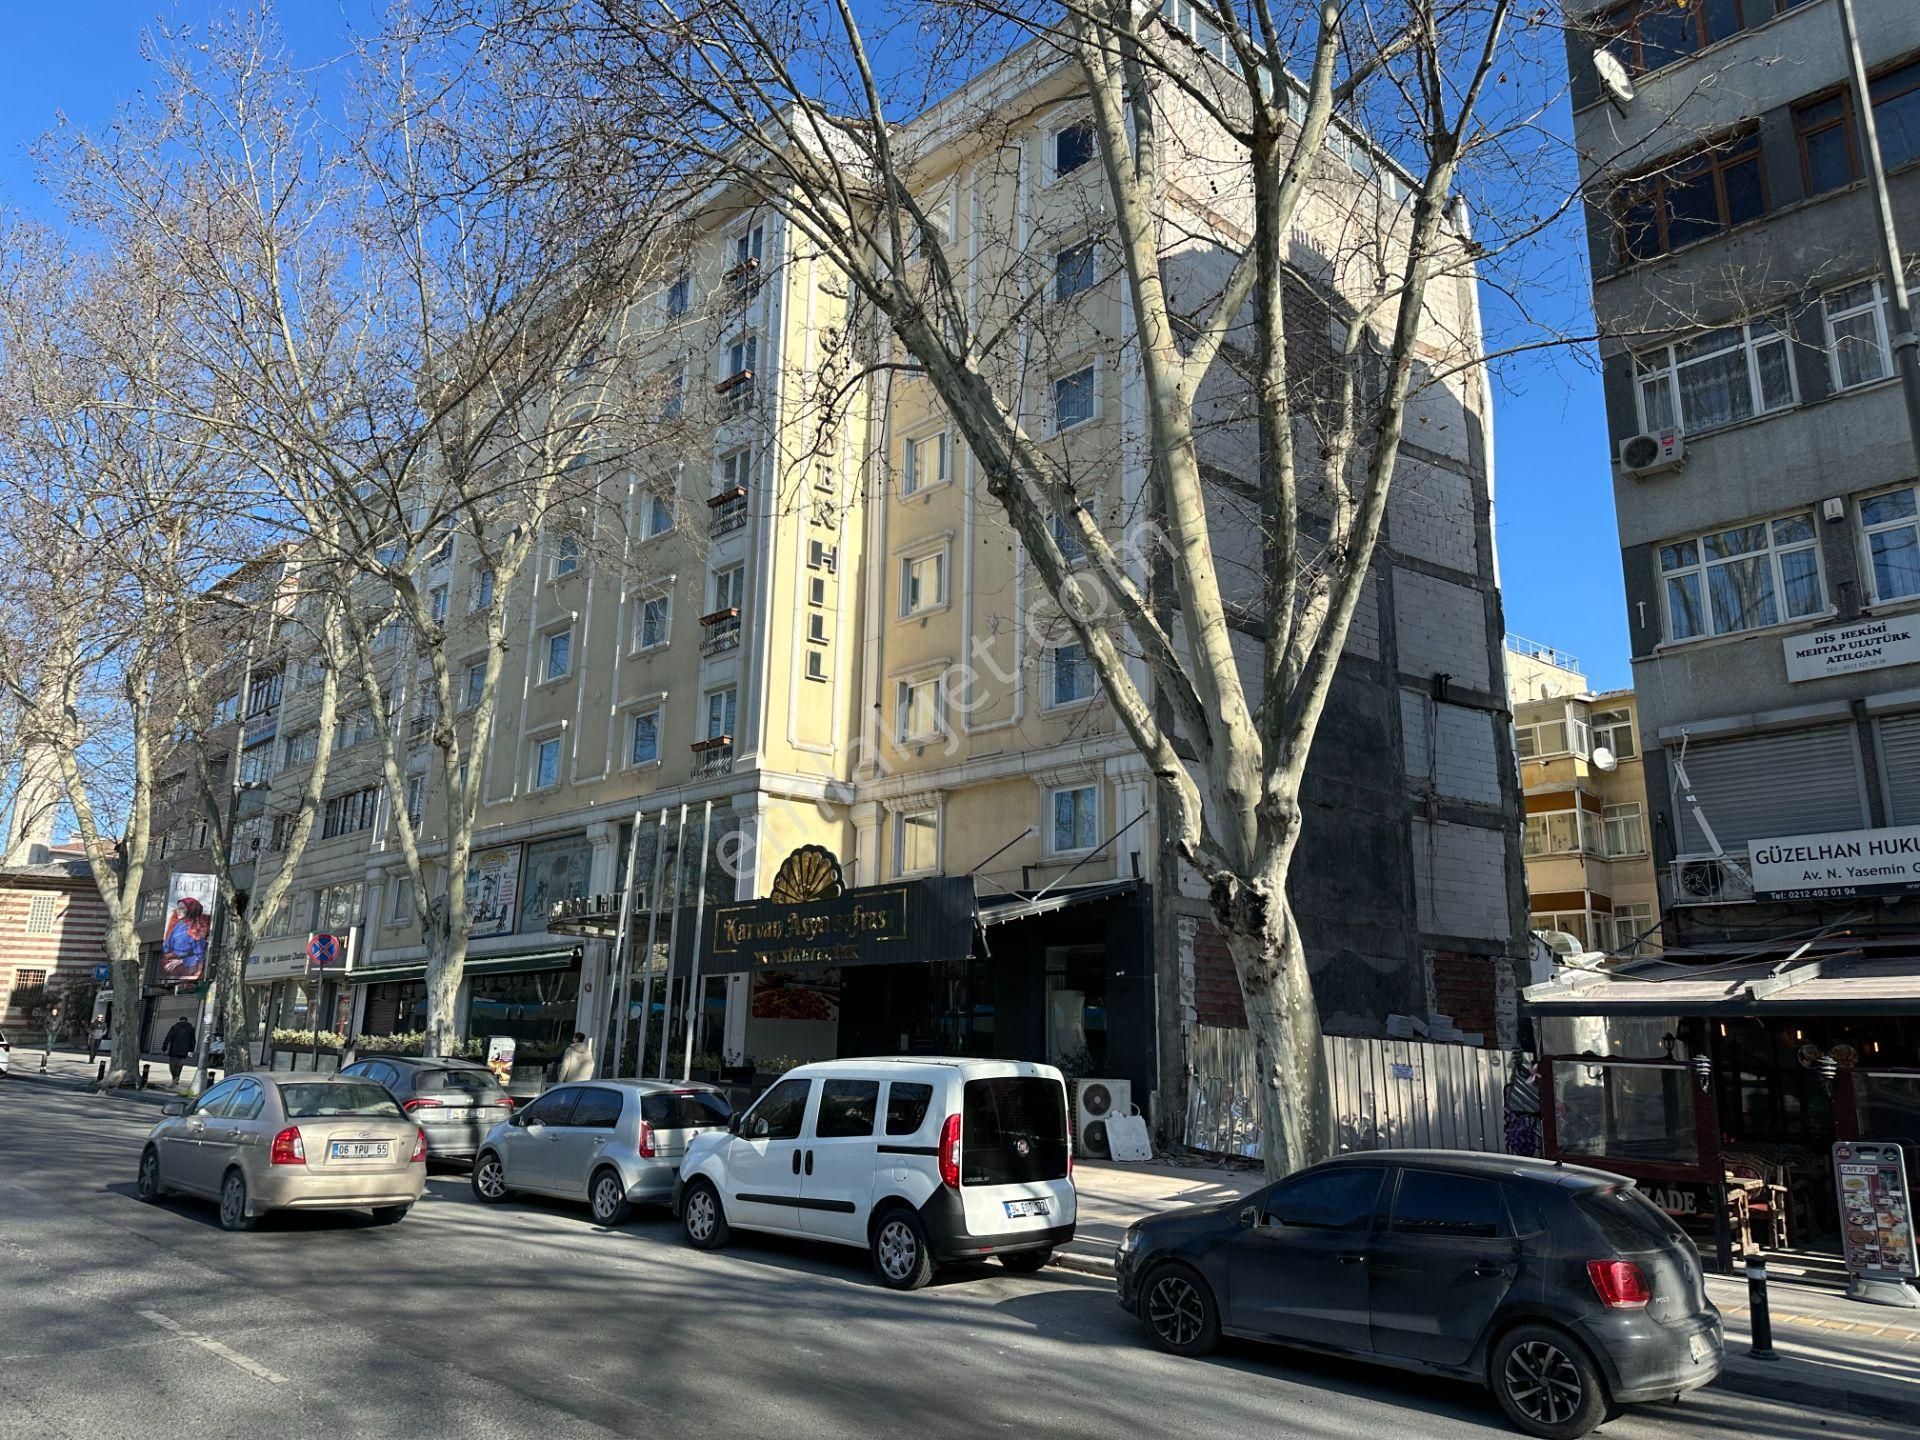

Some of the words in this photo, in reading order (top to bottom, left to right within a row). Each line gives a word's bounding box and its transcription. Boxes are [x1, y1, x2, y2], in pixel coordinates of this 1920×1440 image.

[804, 538, 838, 683] HILL
[1814, 633, 1836, 645] DİŞ
[1841, 622, 1888, 640] HEKİMİ
[1796, 643, 1846, 659] MEHTAP
[1848, 631, 1911, 650] ULUTÜRK
[1826, 647, 1882, 664] ATILGAN
[1755, 842, 1862, 865] GÜZELHAN
[1802, 870, 1822, 881] Av.
[1827, 868, 1842, 879] N.
[1846, 864, 1905, 877] Yasemin
[1770, 892, 1787, 900] Tel:
[1788, 890, 1810, 899] 0212
[1812, 889, 1828, 897] 492
[1844, 887, 1856, 895] 94
[339, 1145, 349, 1154] 06
[354, 1145, 369, 1154] YPU
[1655, 1296, 1670, 1304] POLO
